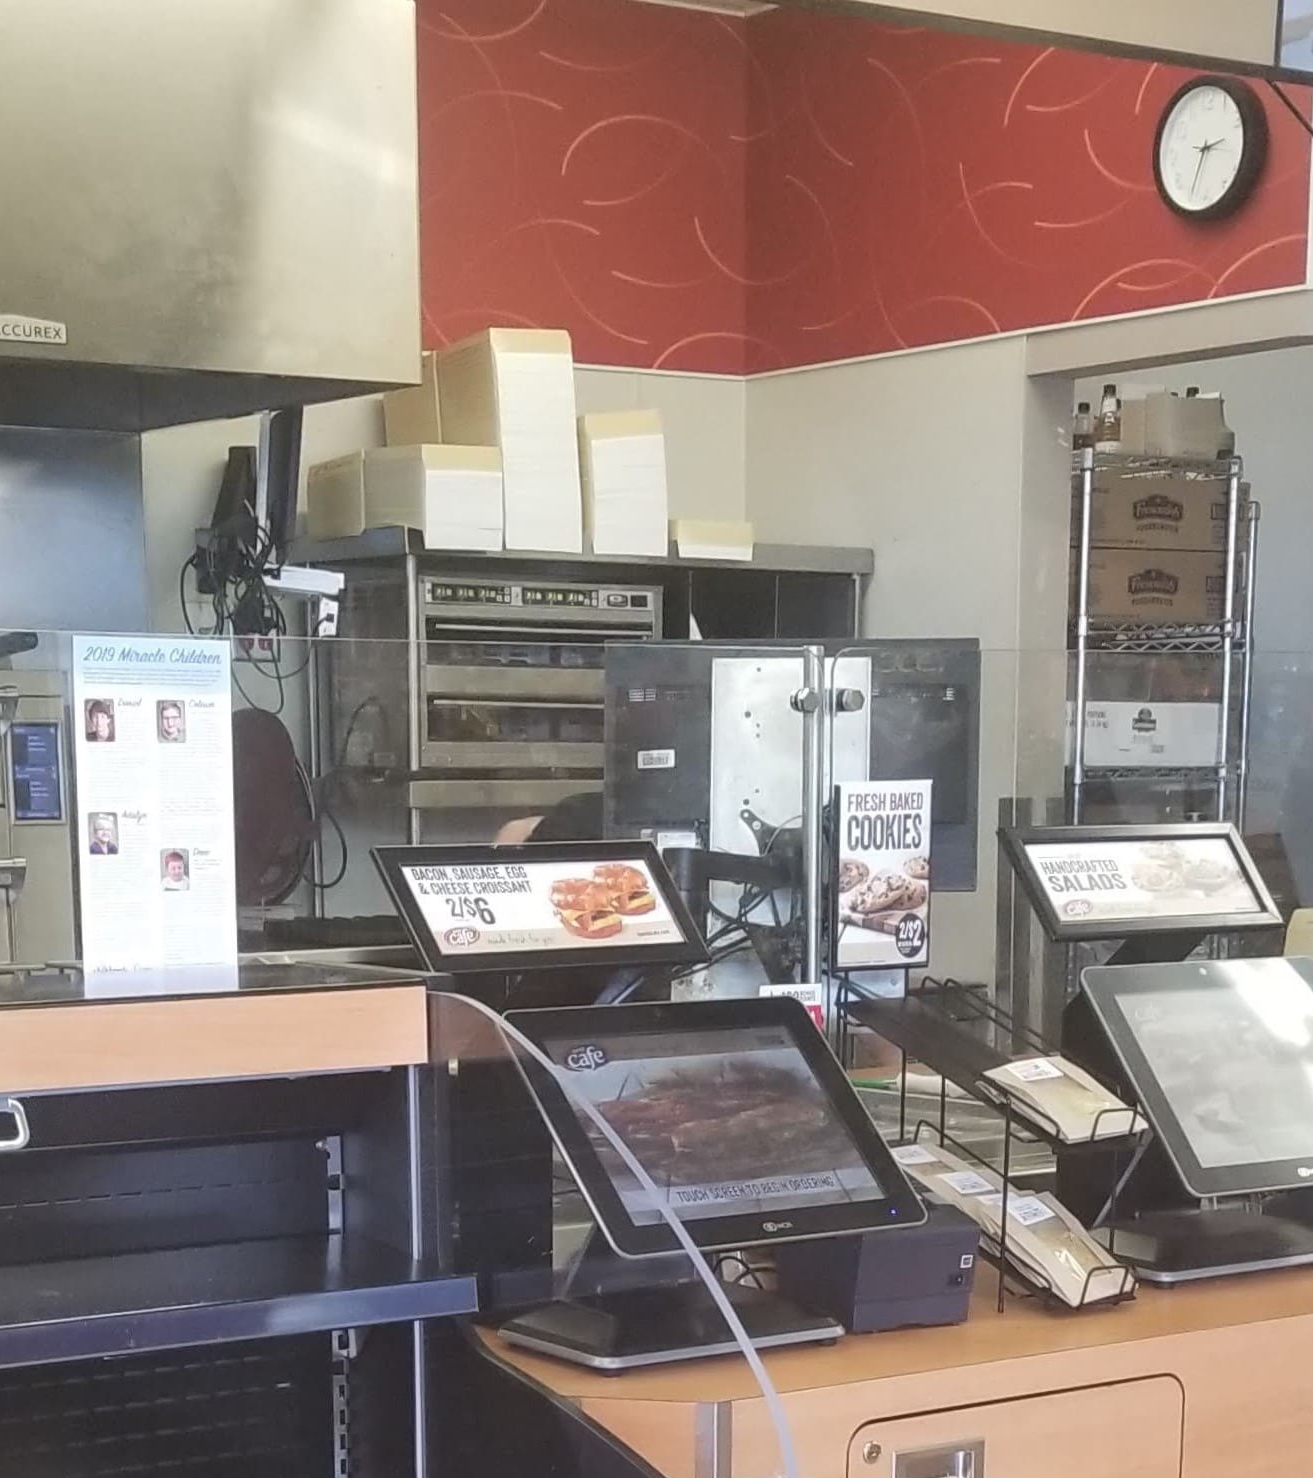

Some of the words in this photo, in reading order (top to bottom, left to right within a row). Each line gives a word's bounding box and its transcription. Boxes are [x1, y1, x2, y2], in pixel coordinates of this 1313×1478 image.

[83, 646, 115, 662] 2019
[117, 648, 166, 664] Miracle
[169, 647, 222, 665] Children
[847, 793, 887, 812] FRESH
[889, 792, 924, 811] BAKED
[847, 813, 922, 851] COOKIES
[411, 867, 451, 881] BACON,
[453, 866, 505, 880] SAUSAGE,
[505, 866, 527, 879] EGG
[1040, 860, 1119, 876] HANDCRAFTED
[430, 882, 473, 896] CHEESE
[473, 880, 533, 895] CROISSANT
[1048, 873, 1128, 893] SALADS
[676, 1189, 708, 1203] TOUCH
